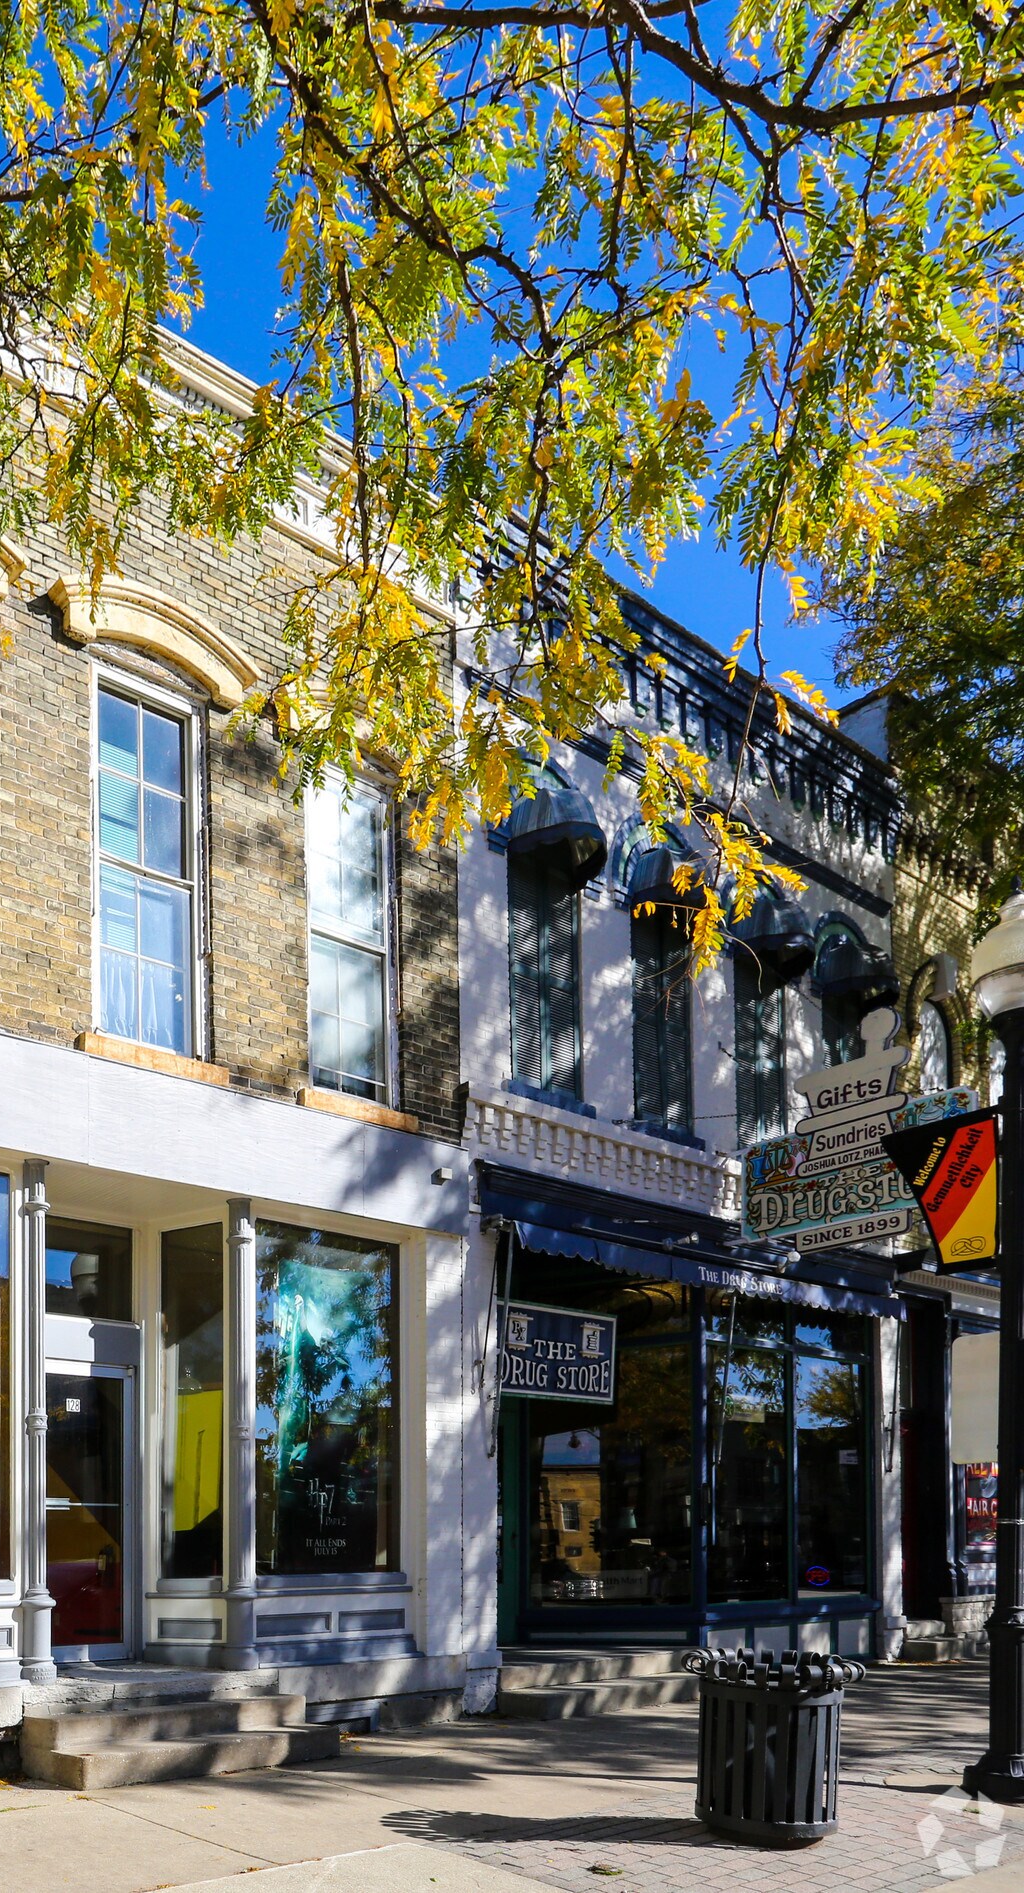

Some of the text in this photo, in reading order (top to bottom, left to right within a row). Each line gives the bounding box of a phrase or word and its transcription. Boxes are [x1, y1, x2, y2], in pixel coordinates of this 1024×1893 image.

[816, 1078, 882, 1109] Gifts
[815, 1122, 887, 1152] Sundries
[802, 1159, 837, 1174] JOSHUA
[819, 1163, 881, 1187] THE
[913, 1136, 946, 1187] Welcome to
[926, 1127, 984, 1213] Gemuetlichkeit
[959, 1163, 984, 1188] City
[801, 1216, 901, 1247] SINCE 1899
[698, 1265, 720, 1284] THE
[750, 1276, 783, 1295] STORE
[533, 1338, 577, 1360] THE
[556, 1359, 611, 1394] STORE
[66, 1399, 81, 1412] 128
[306, 1537, 347, 1548] IT ALL ENDS
[314, 1547, 331, 1557] JULY
